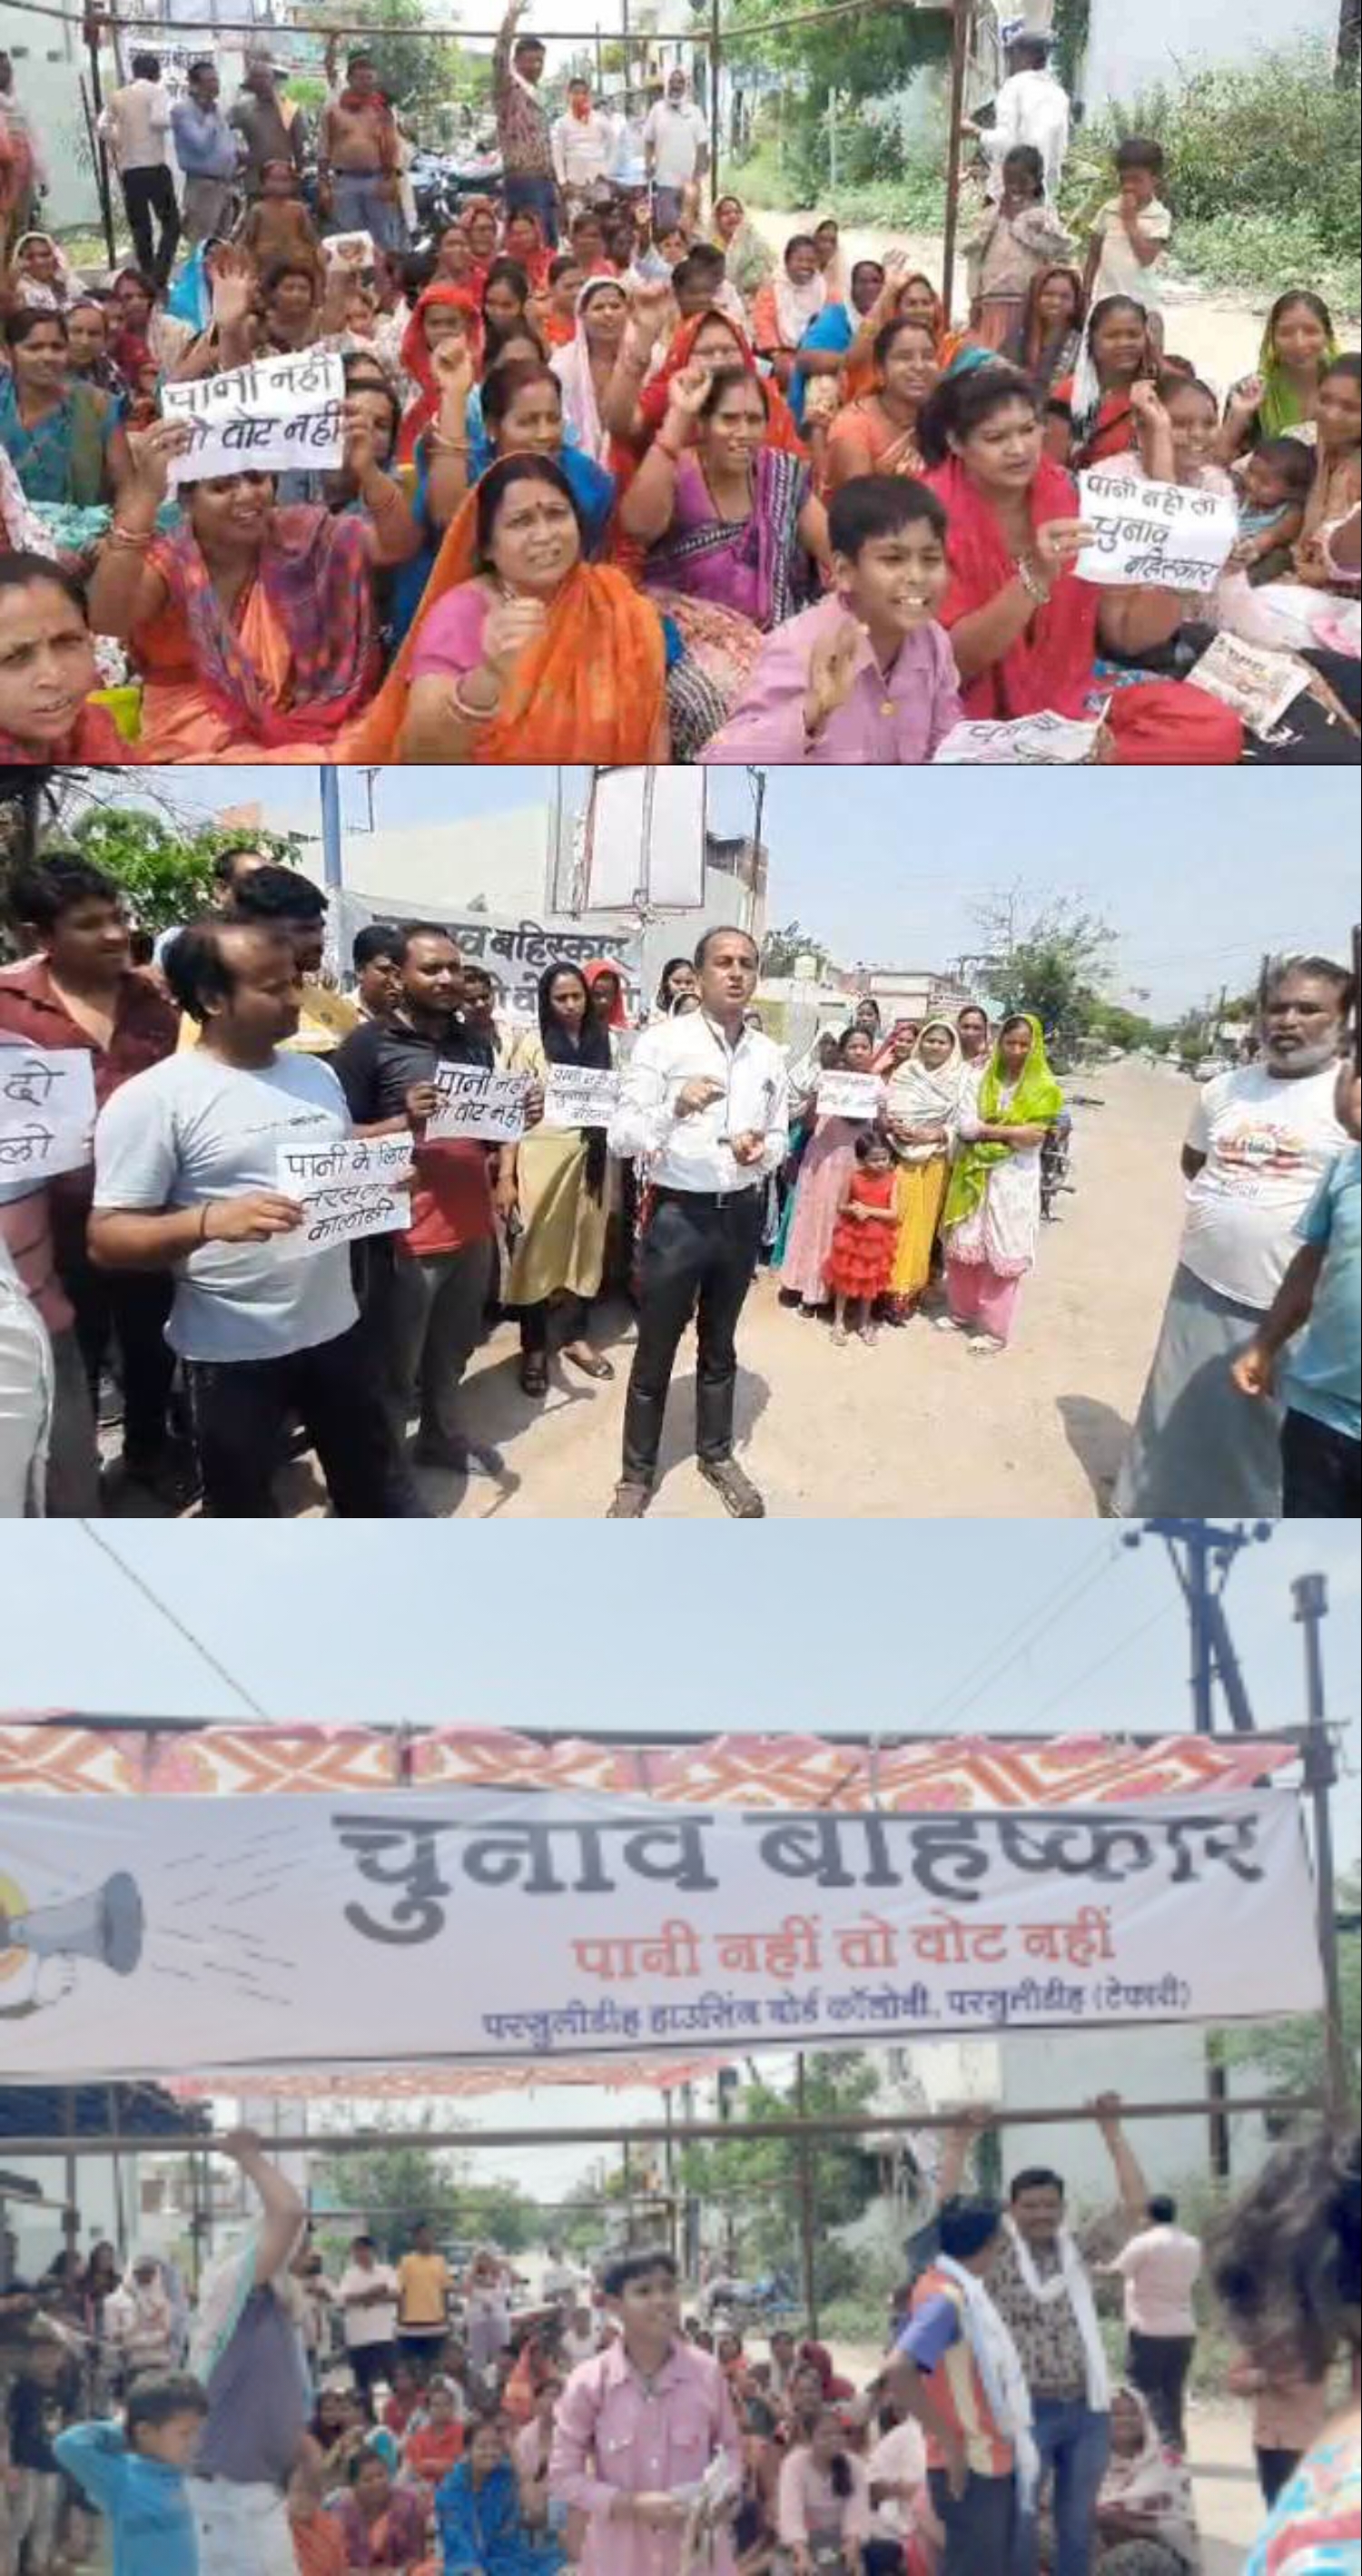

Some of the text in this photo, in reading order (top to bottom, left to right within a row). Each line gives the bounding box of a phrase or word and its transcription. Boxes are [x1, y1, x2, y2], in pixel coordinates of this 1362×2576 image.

[222, 406, 281, 449] वोट
[1088, 475, 1137, 498] पानी
[1091, 515, 1172, 553] चुनाव
[284, 1143, 349, 1178] पानी
[331, 1814, 719, 1945] चुनाव
[571, 1905, 1117, 1980] पानी नहीं तो वोट नहीं
